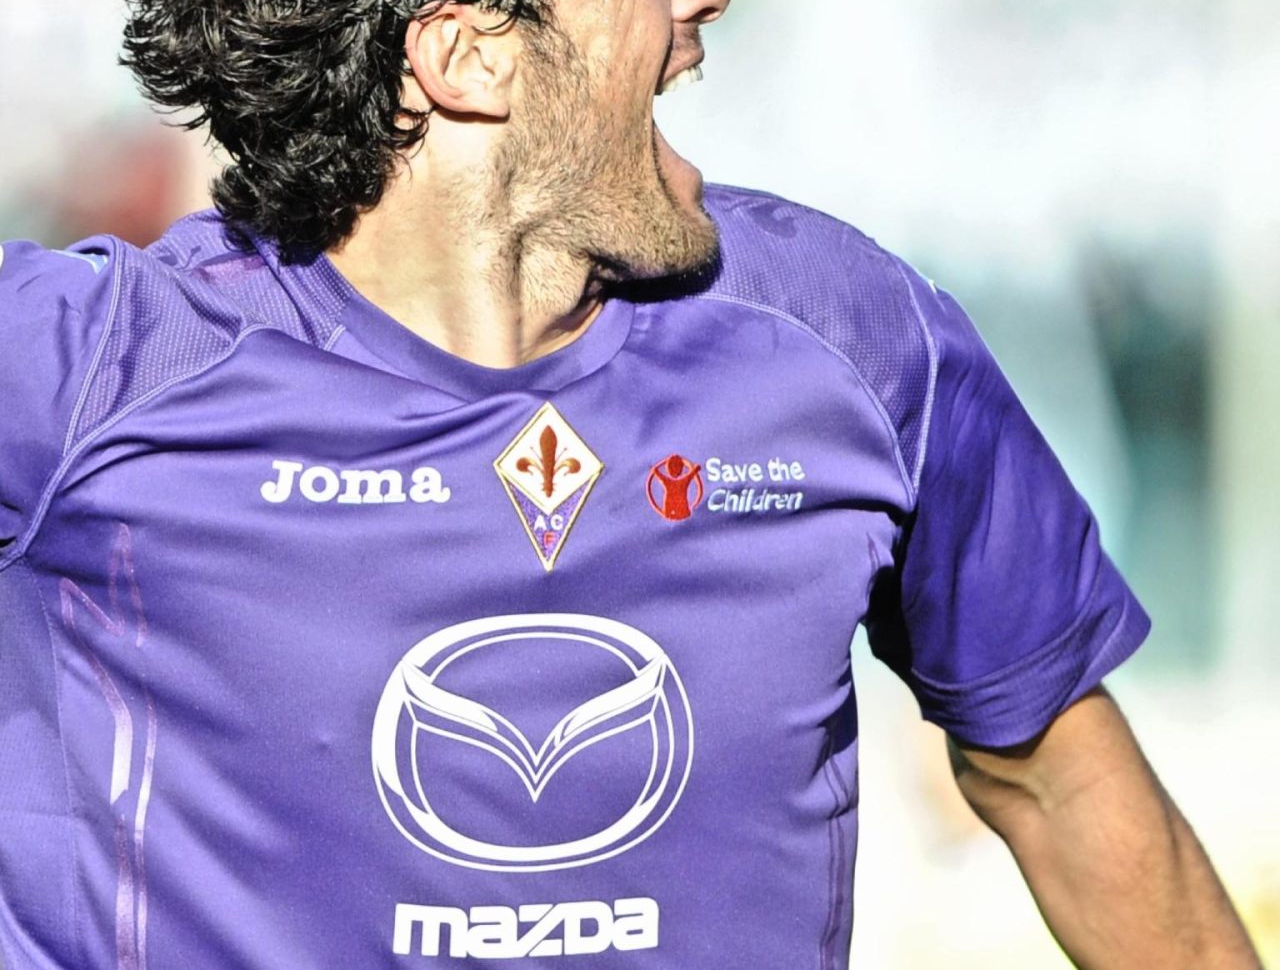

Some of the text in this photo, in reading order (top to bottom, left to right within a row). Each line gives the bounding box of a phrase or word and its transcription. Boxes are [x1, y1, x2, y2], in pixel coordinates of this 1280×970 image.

[705, 457, 806, 482] Save the
[260, 460, 451, 504] Joma
[707, 488, 804, 512] Children
[543, 531, 556, 545] F
